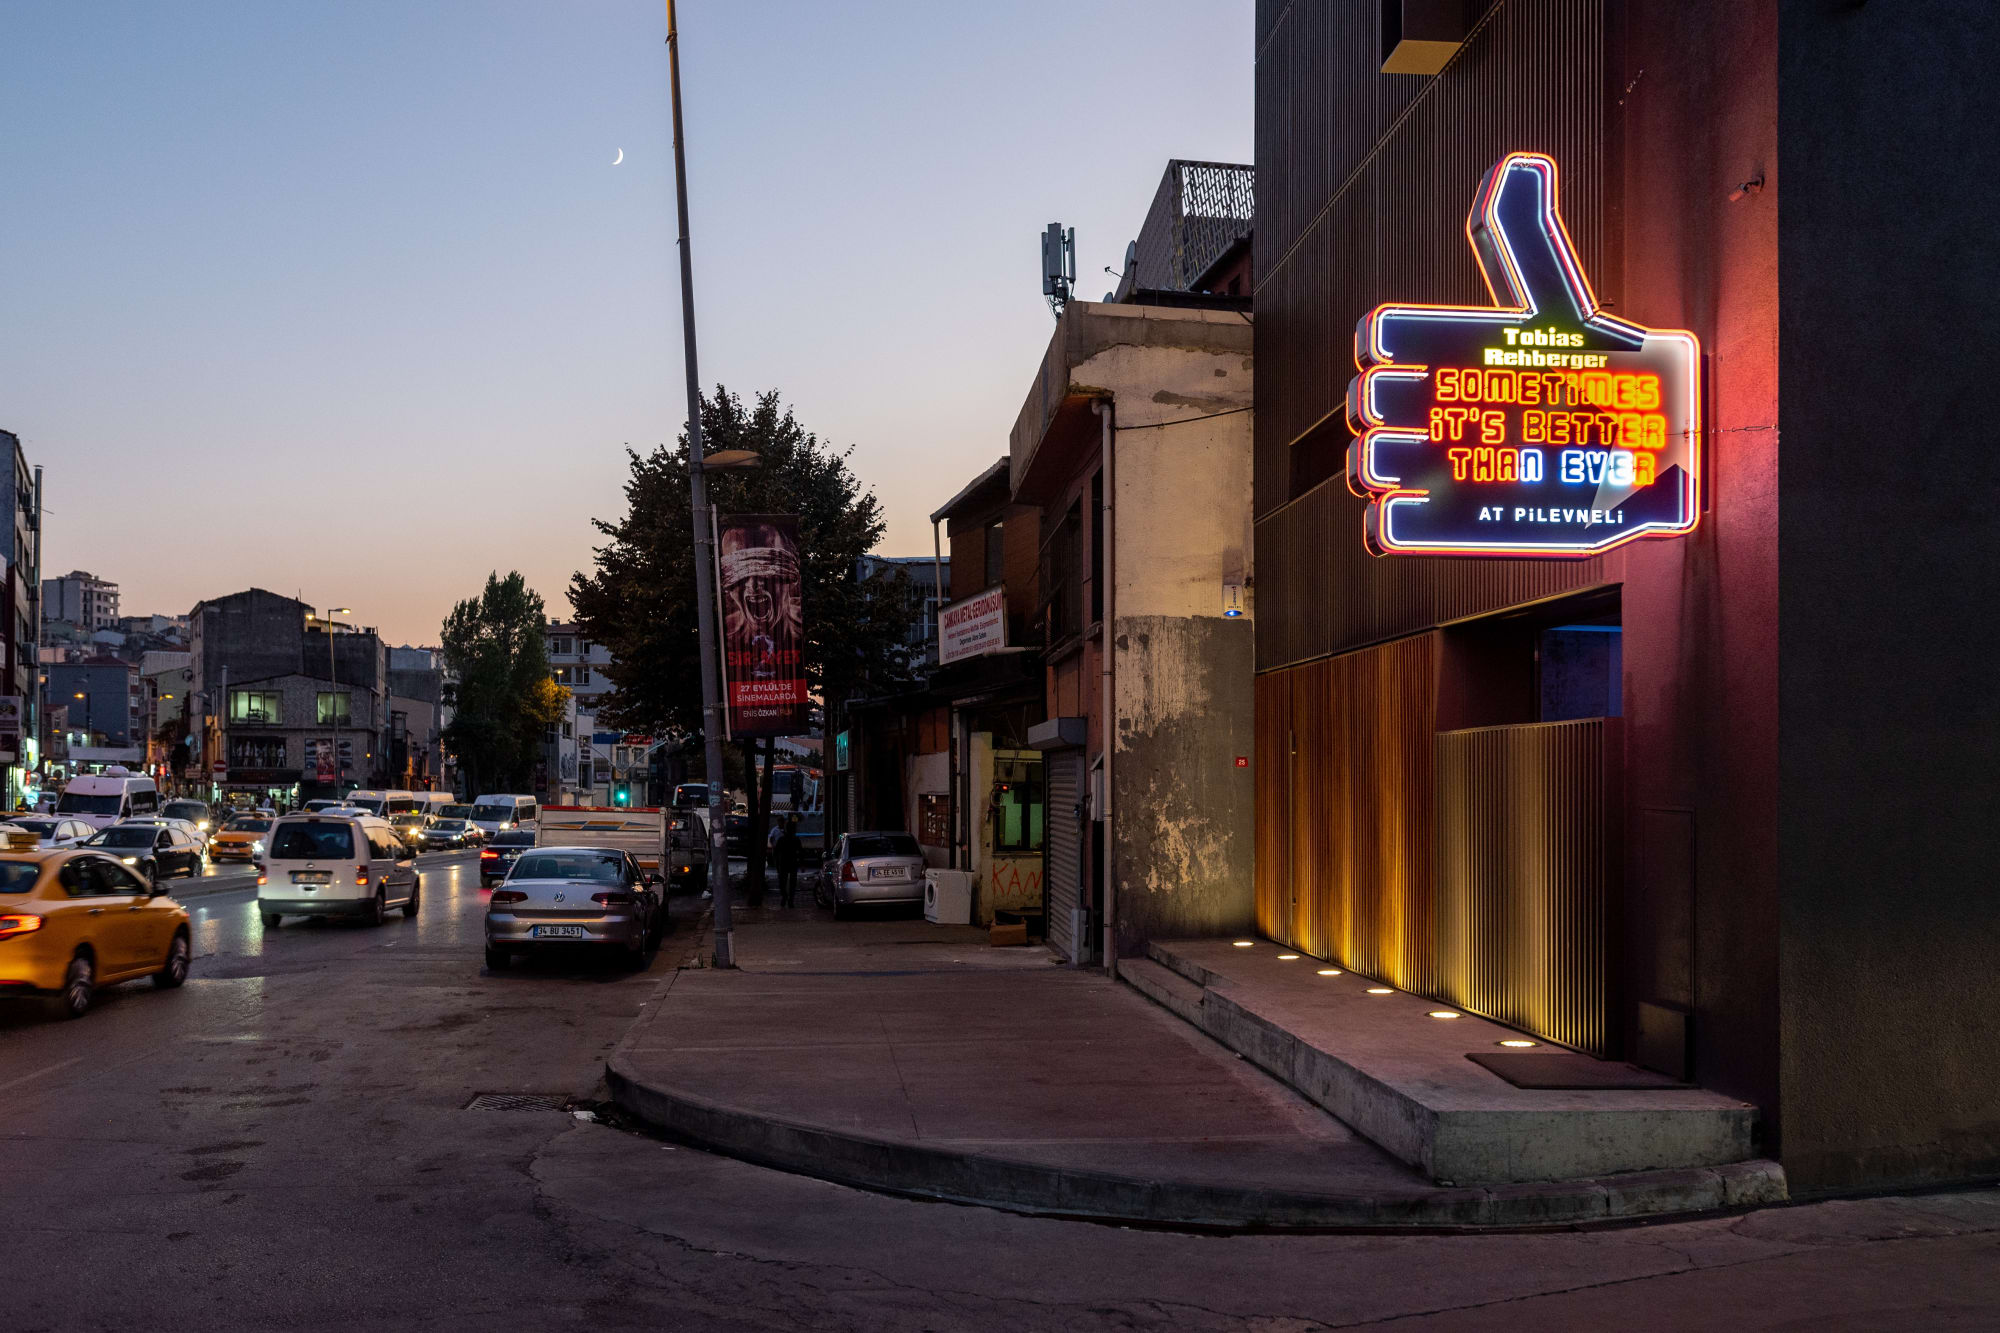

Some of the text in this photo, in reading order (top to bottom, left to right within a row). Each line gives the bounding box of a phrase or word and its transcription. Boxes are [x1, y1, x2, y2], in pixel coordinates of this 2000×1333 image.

[1502, 326, 1585, 348] Tobias
[1484, 348, 1608, 370] Rehberger
[1523, 410, 1667, 449] BETTER
[1448, 447, 1656, 487] THAN EVER
[1479, 506, 1504, 522] AT
[740, 683, 793, 693] 27 EYLÜL'DE
[736, 692, 797, 702] SİNEMALARDA
[757, 708, 777, 717] ÖZKAN
[538, 927, 579, 935] 34 BU 3451
